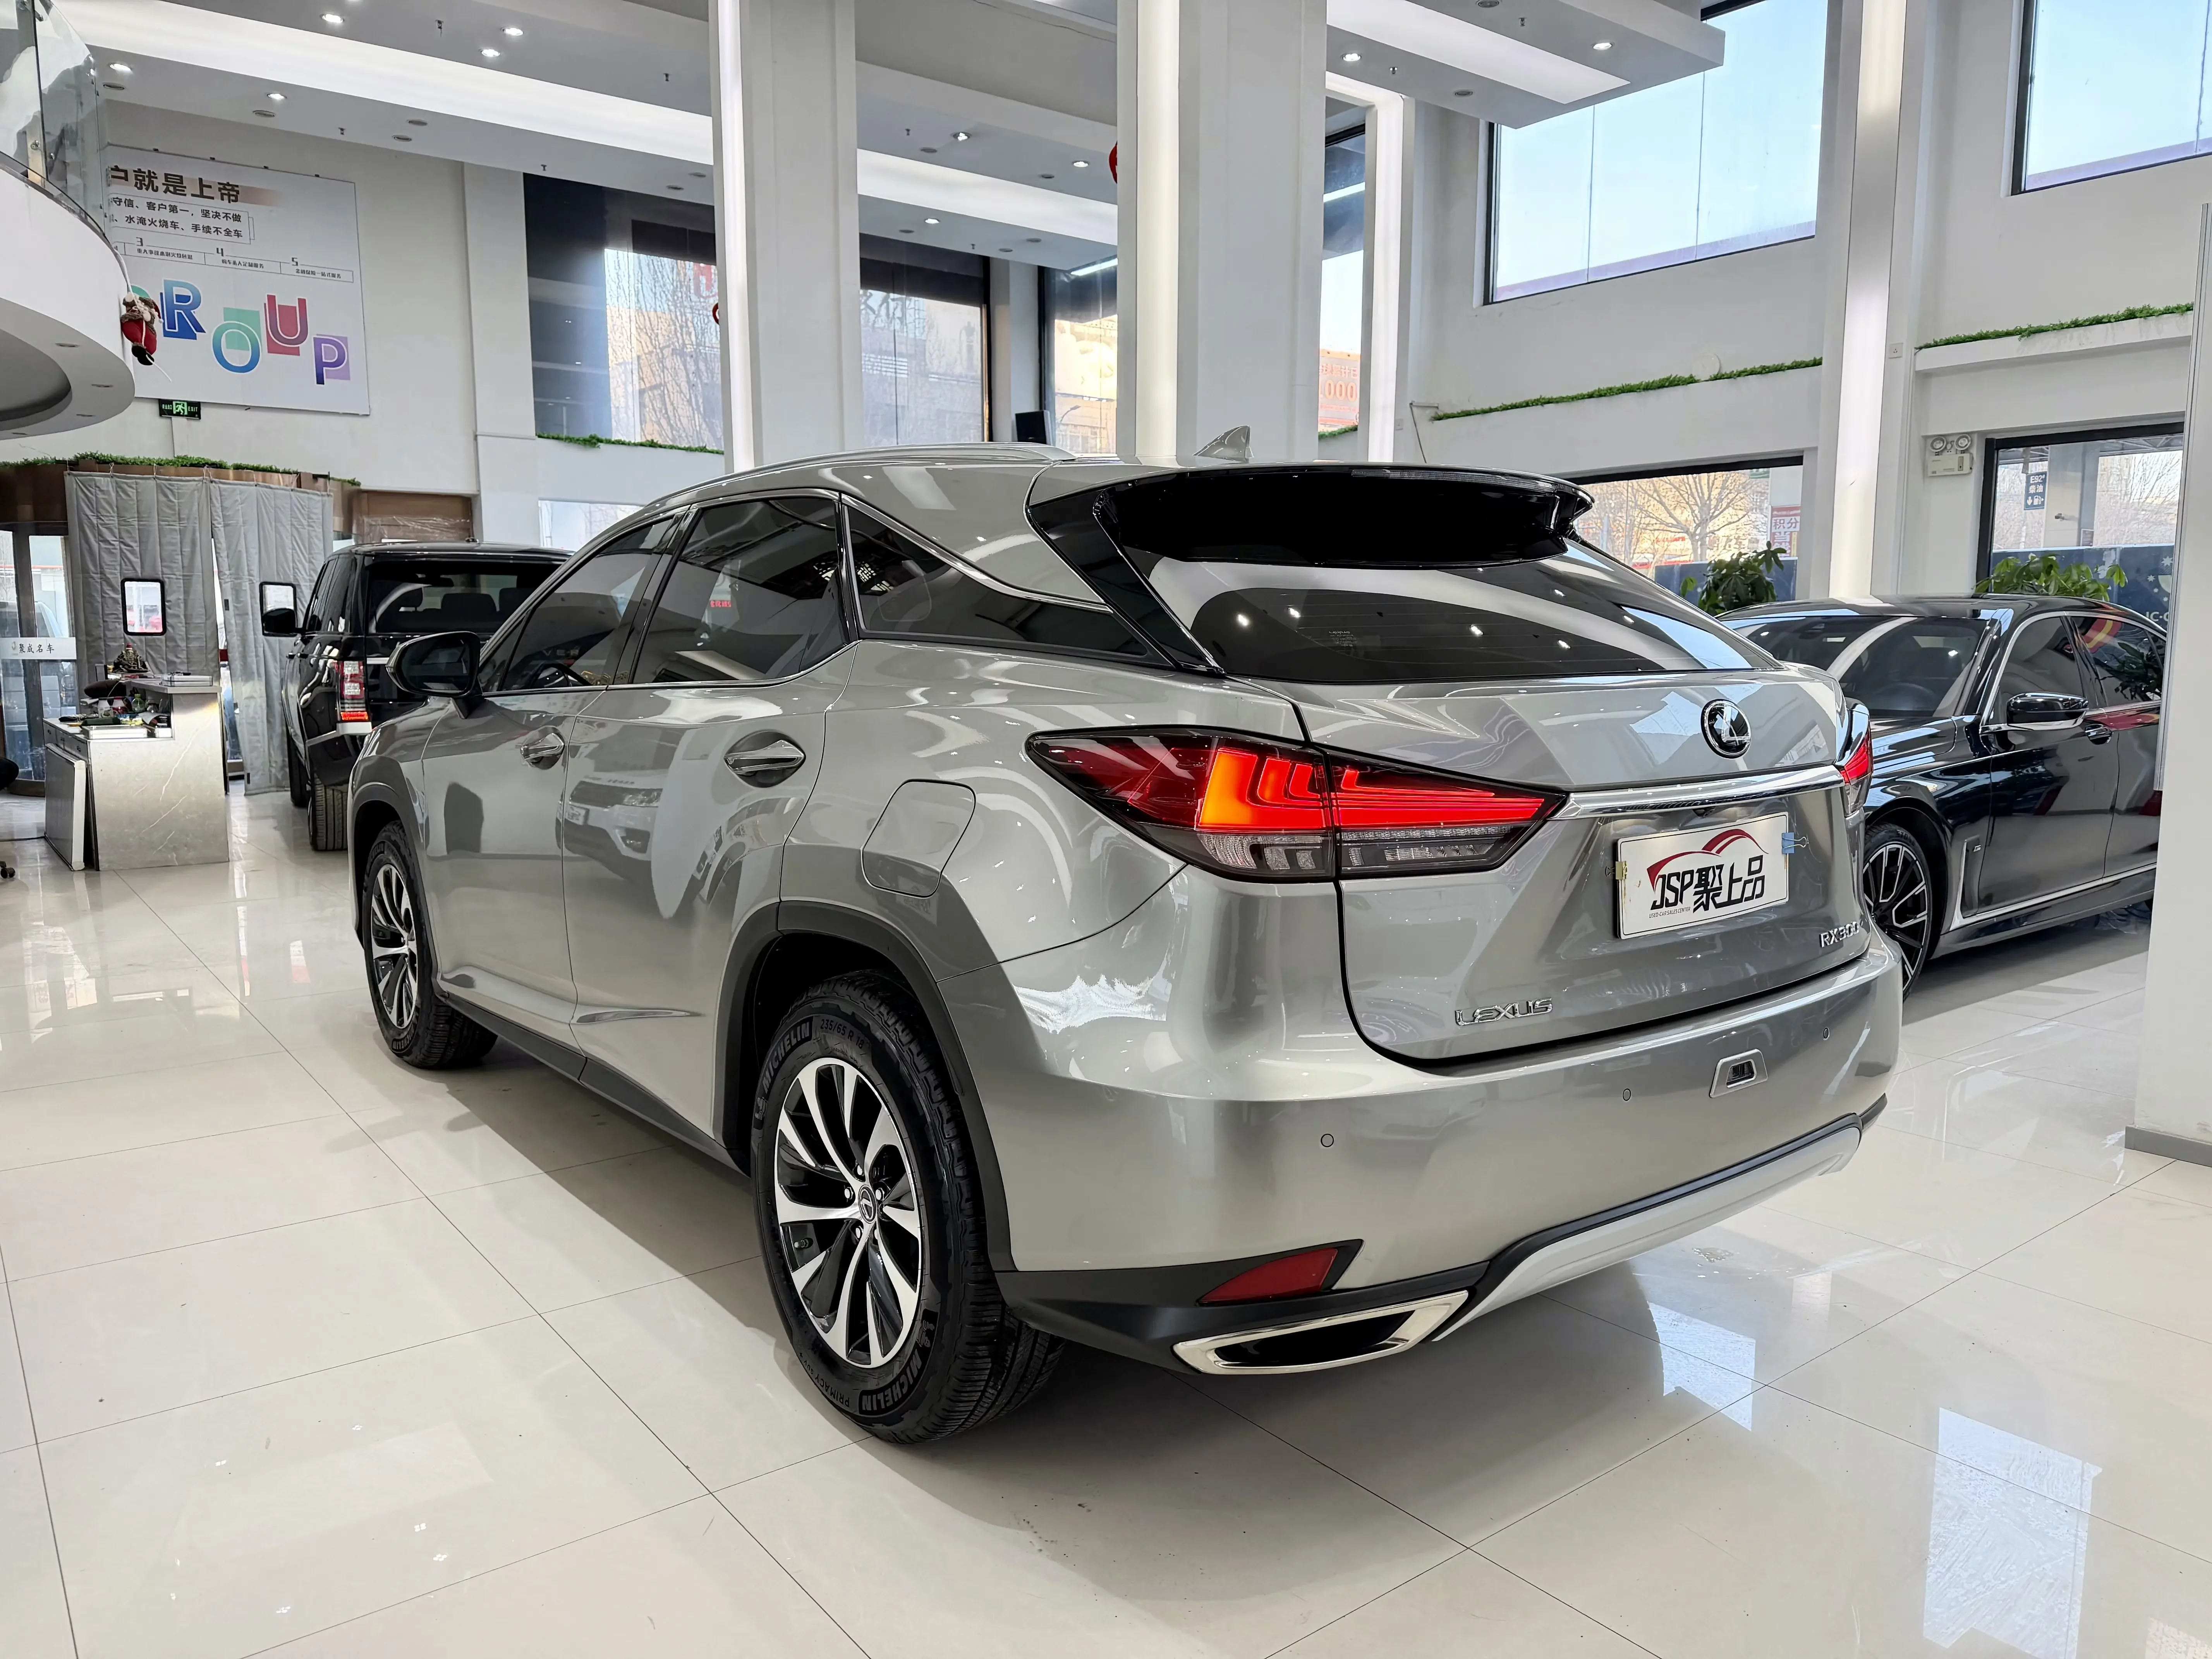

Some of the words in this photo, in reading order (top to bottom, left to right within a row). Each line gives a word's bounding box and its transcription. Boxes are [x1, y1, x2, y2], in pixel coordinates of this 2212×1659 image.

[136, 237, 143, 246] 3
[216, 248, 224, 256] 4
[292, 257, 299, 266] 5
[2029, 484, 2044, 494] 柴油
[1773, 517, 1799, 530] 积分
[1820, 921, 1859, 947] RX300
[1455, 998, 1553, 1026] LEXUS
[820, 1019, 847, 1036] 235/65
[847, 1031, 854, 1042] R
[856, 1036, 865, 1049] 18
[763, 1021, 810, 1094] MICHELIN
[803, 1359, 814, 1375] SUV
[862, 1349, 922, 1411] MICHELIN
[814, 1374, 850, 1408] PRIMACY
